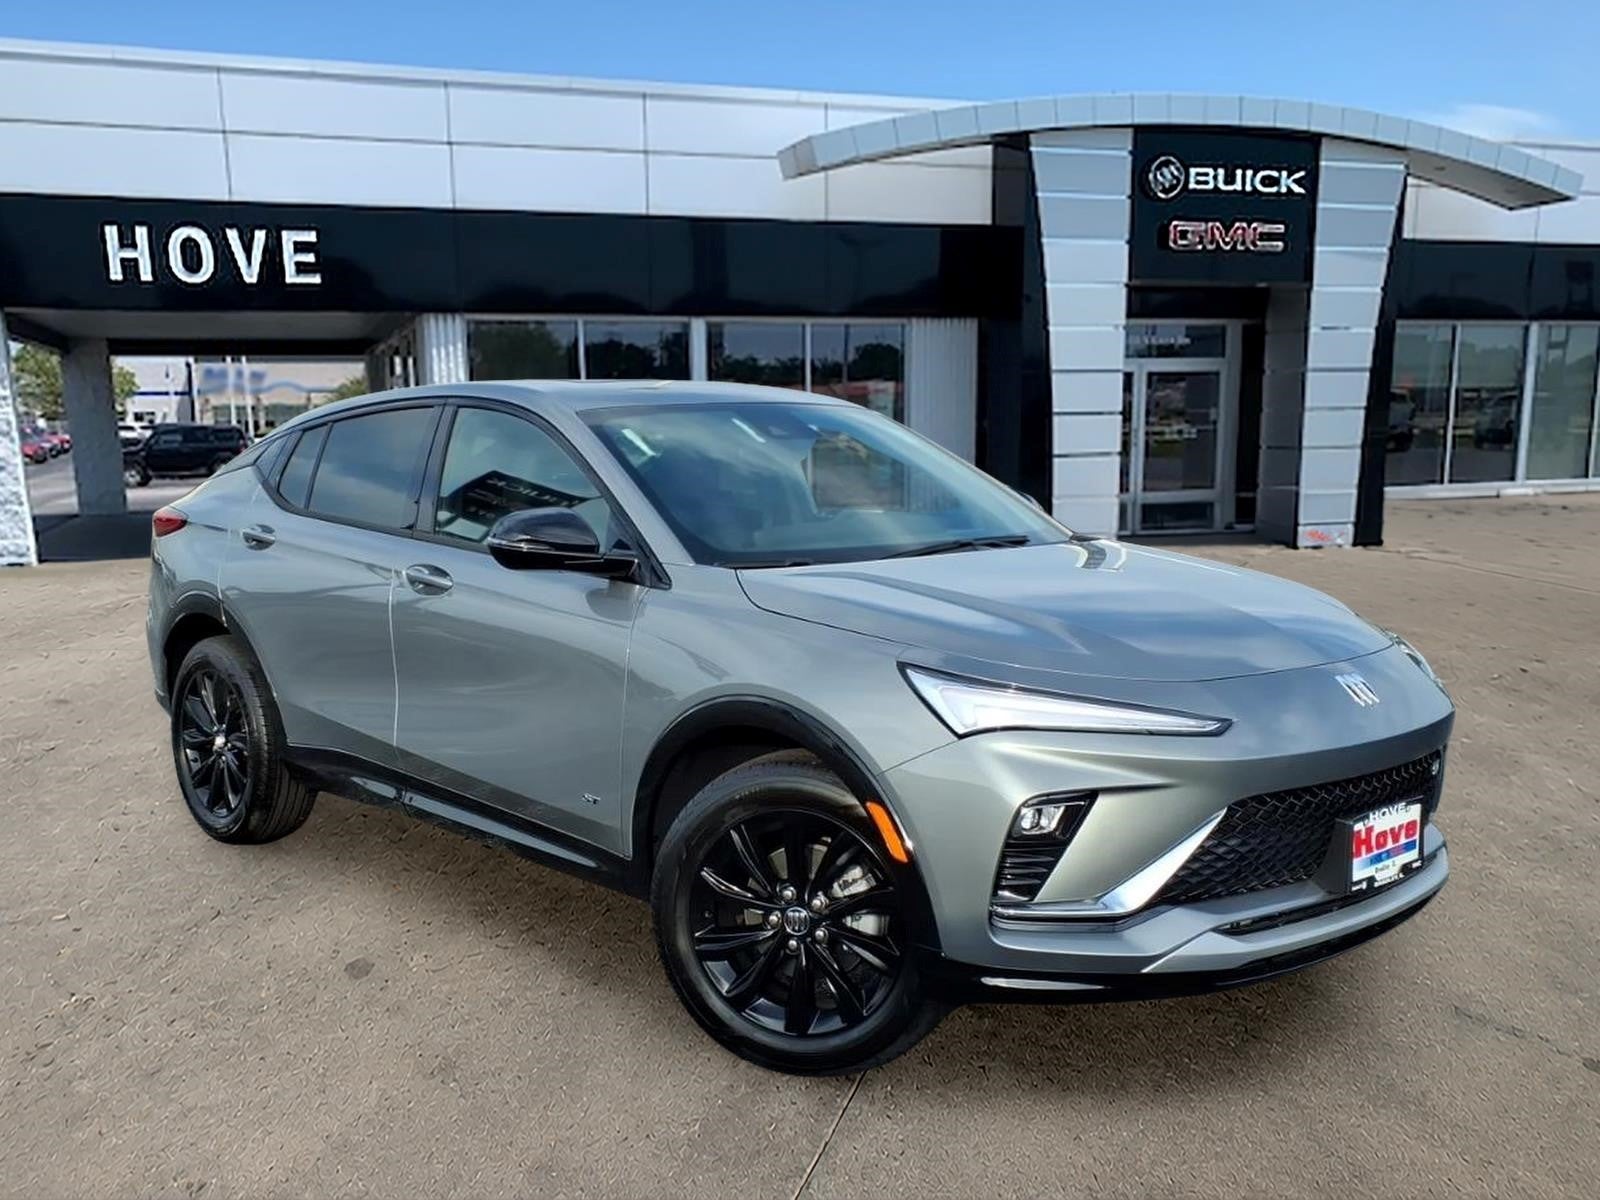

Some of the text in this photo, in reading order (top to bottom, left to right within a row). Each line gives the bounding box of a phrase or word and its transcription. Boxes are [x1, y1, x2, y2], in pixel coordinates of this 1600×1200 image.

[1188, 167, 1306, 194] BUICK
[1169, 220, 1285, 252] GMC
[104, 224, 322, 284] HOVE
[1369, 802, 1407, 821] HOVE
[1352, 819, 1418, 858] Hove
